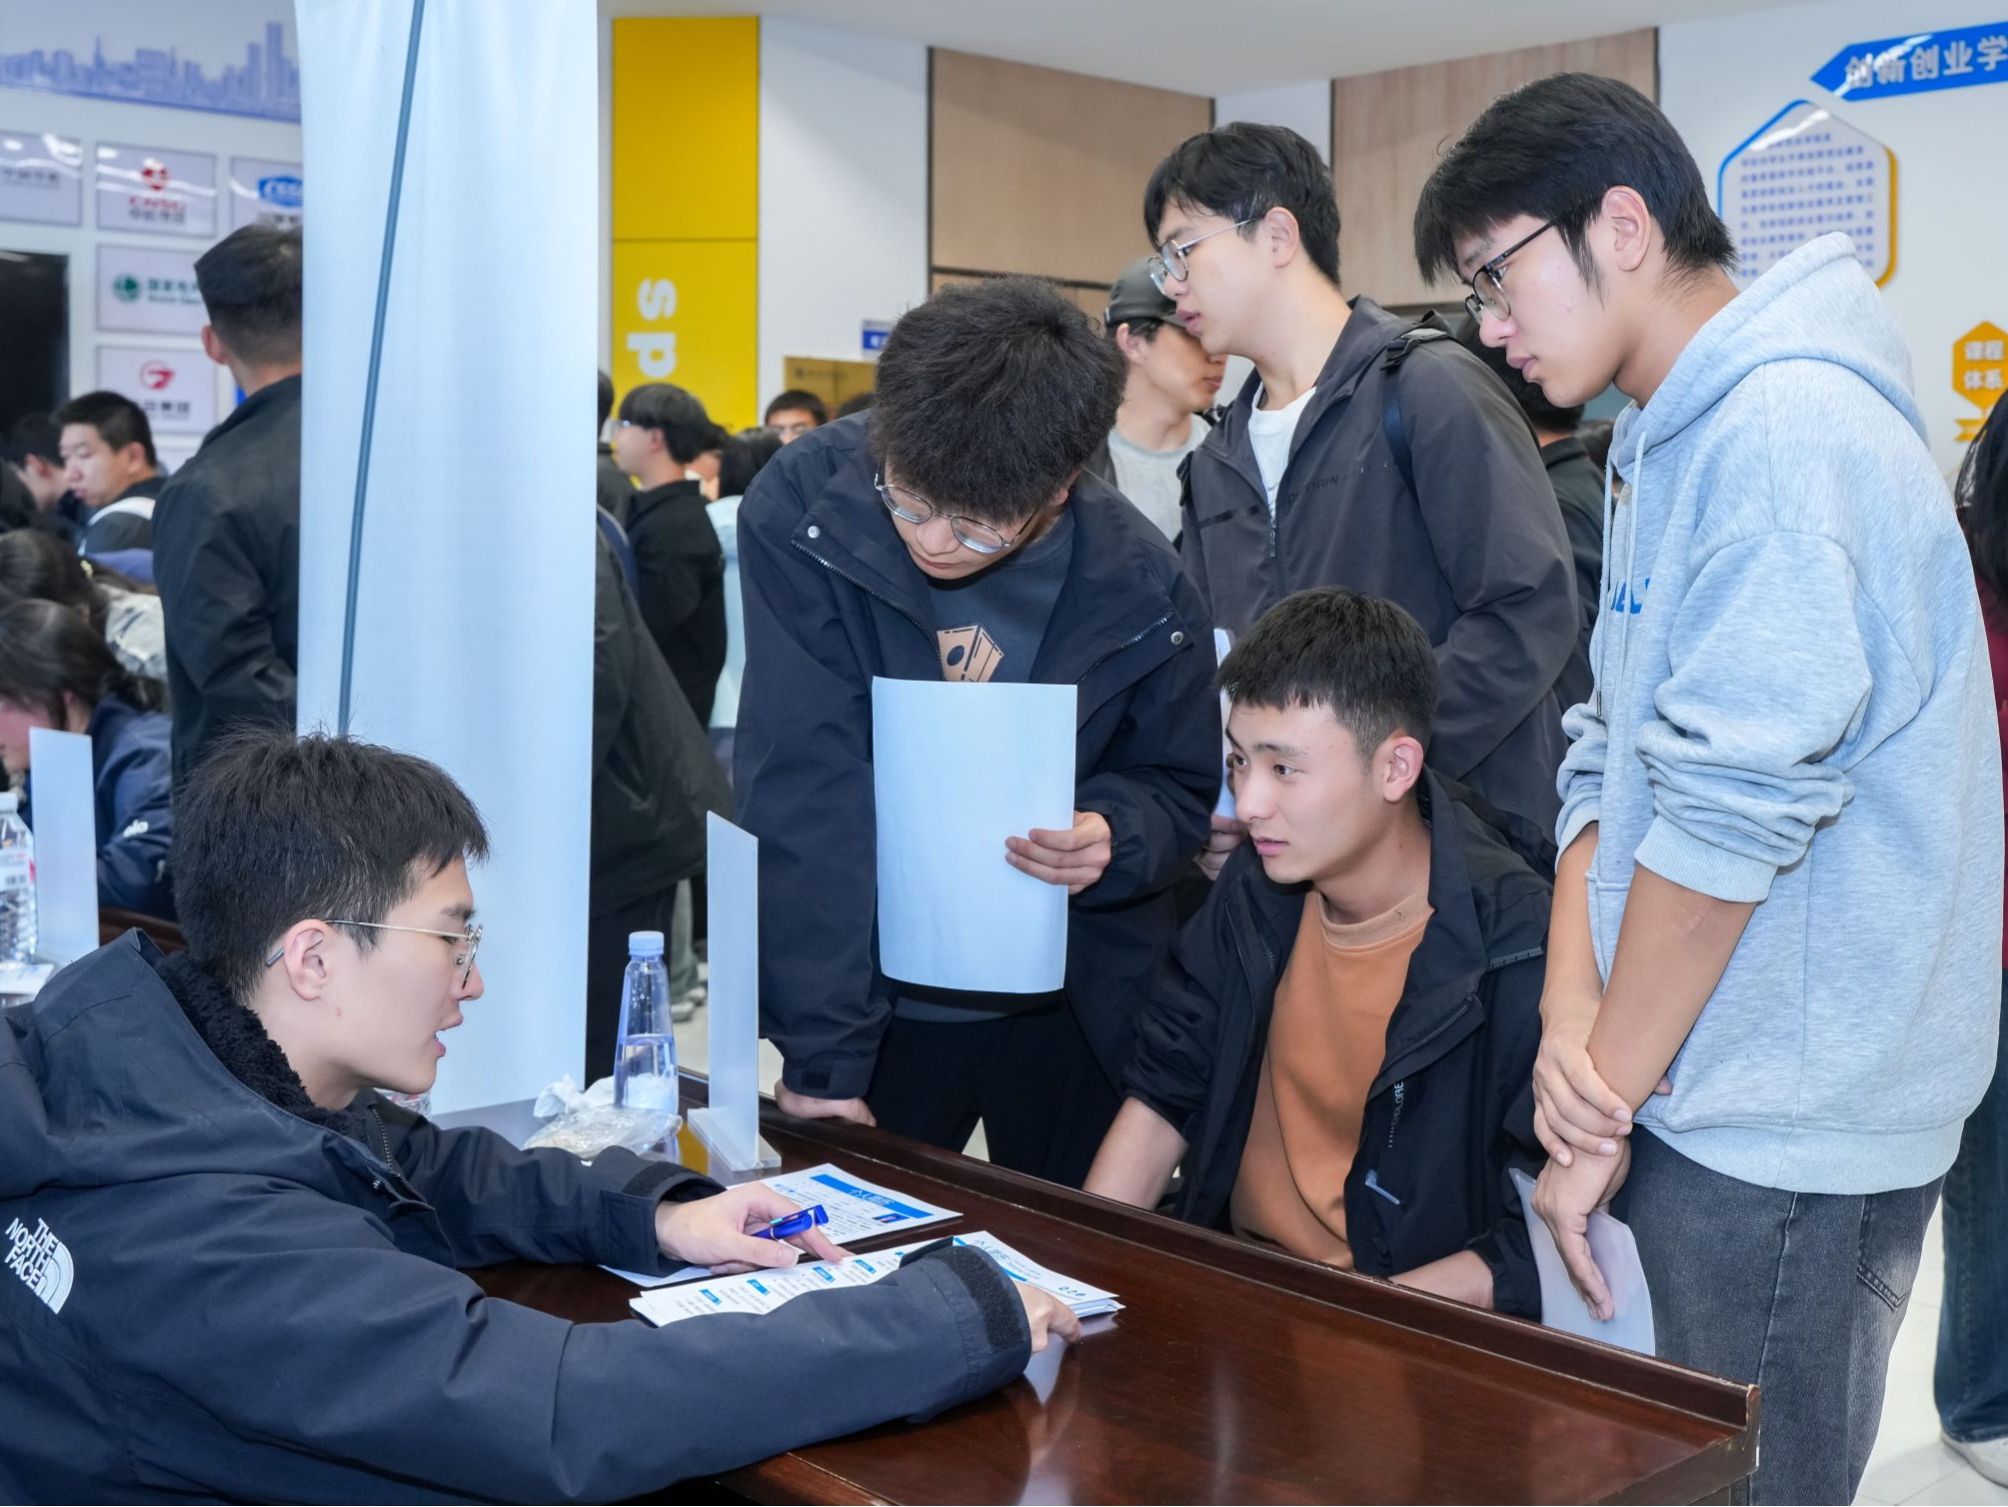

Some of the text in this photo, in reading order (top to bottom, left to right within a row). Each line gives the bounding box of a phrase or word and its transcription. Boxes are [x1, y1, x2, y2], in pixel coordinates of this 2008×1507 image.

[1845, 34, 2008, 89] 创新创业学
[5, 1217, 51, 1275] NORTH
[33, 1217, 59, 1256] THE
[4, 1245, 42, 1291] FACE
